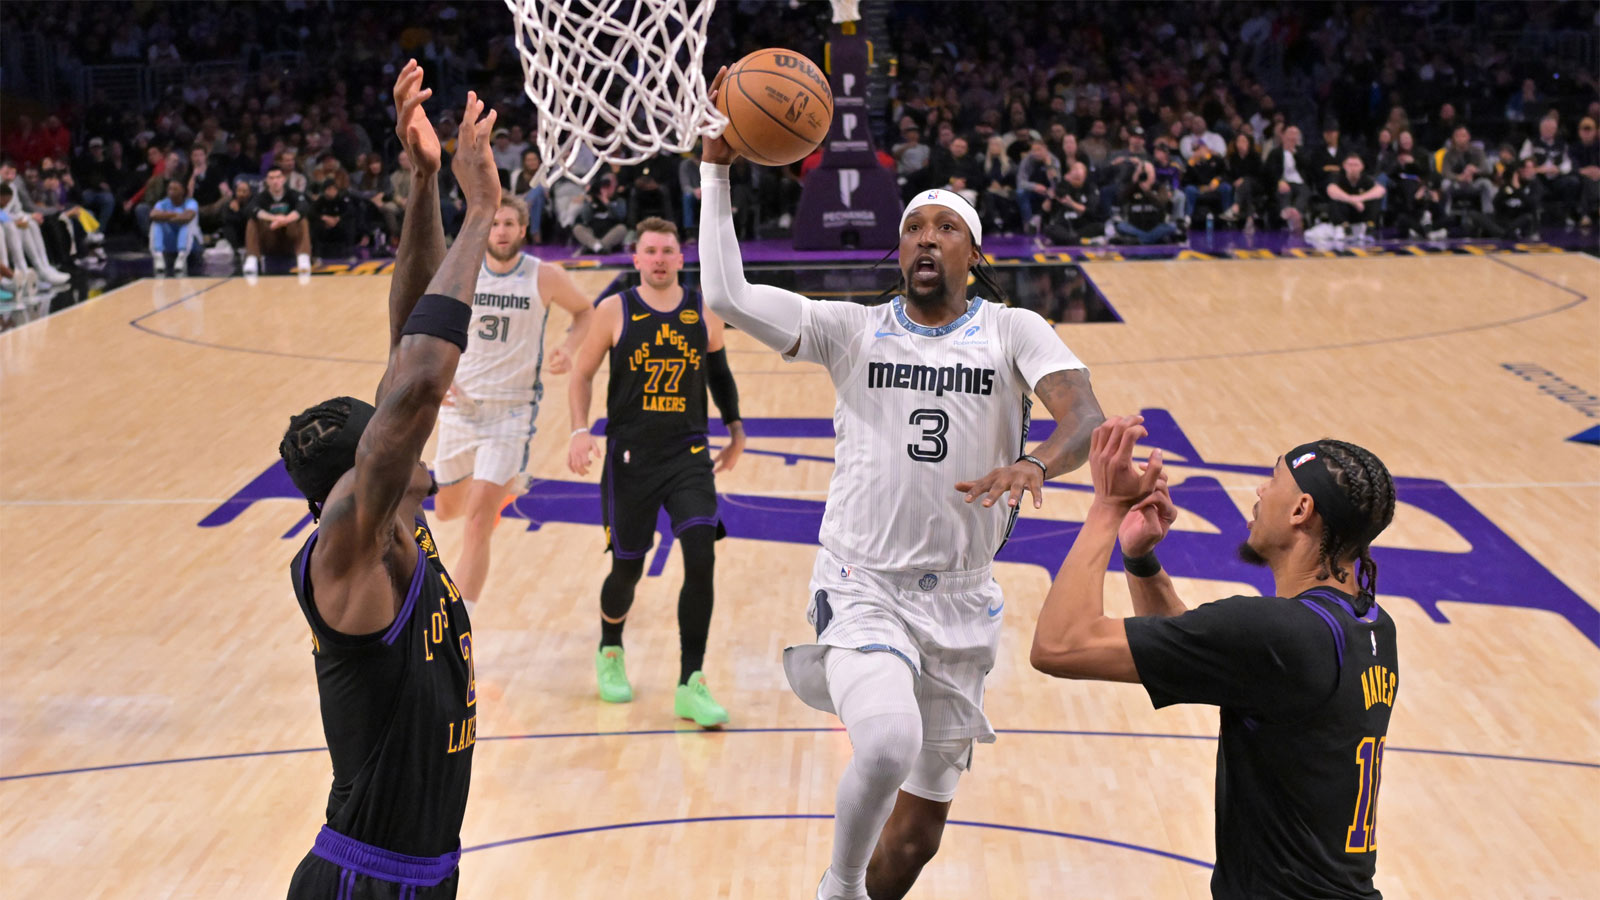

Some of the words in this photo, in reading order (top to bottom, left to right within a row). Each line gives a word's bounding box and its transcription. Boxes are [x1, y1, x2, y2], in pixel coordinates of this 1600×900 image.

[773, 54, 833, 106] Wilson
[478, 314, 510, 343] 31
[628, 342, 650, 371] LOS
[655, 323, 701, 371] ANGELES
[644, 359, 686, 393] 77
[868, 362, 995, 397] memphis
[642, 395, 687, 412] LAKERS
[907, 408, 949, 463] 3
[423, 597, 449, 662] LOS
[459, 631, 477, 708] 2
[1360, 665, 1396, 711] HAYES
[1345, 736, 1386, 853] 11
